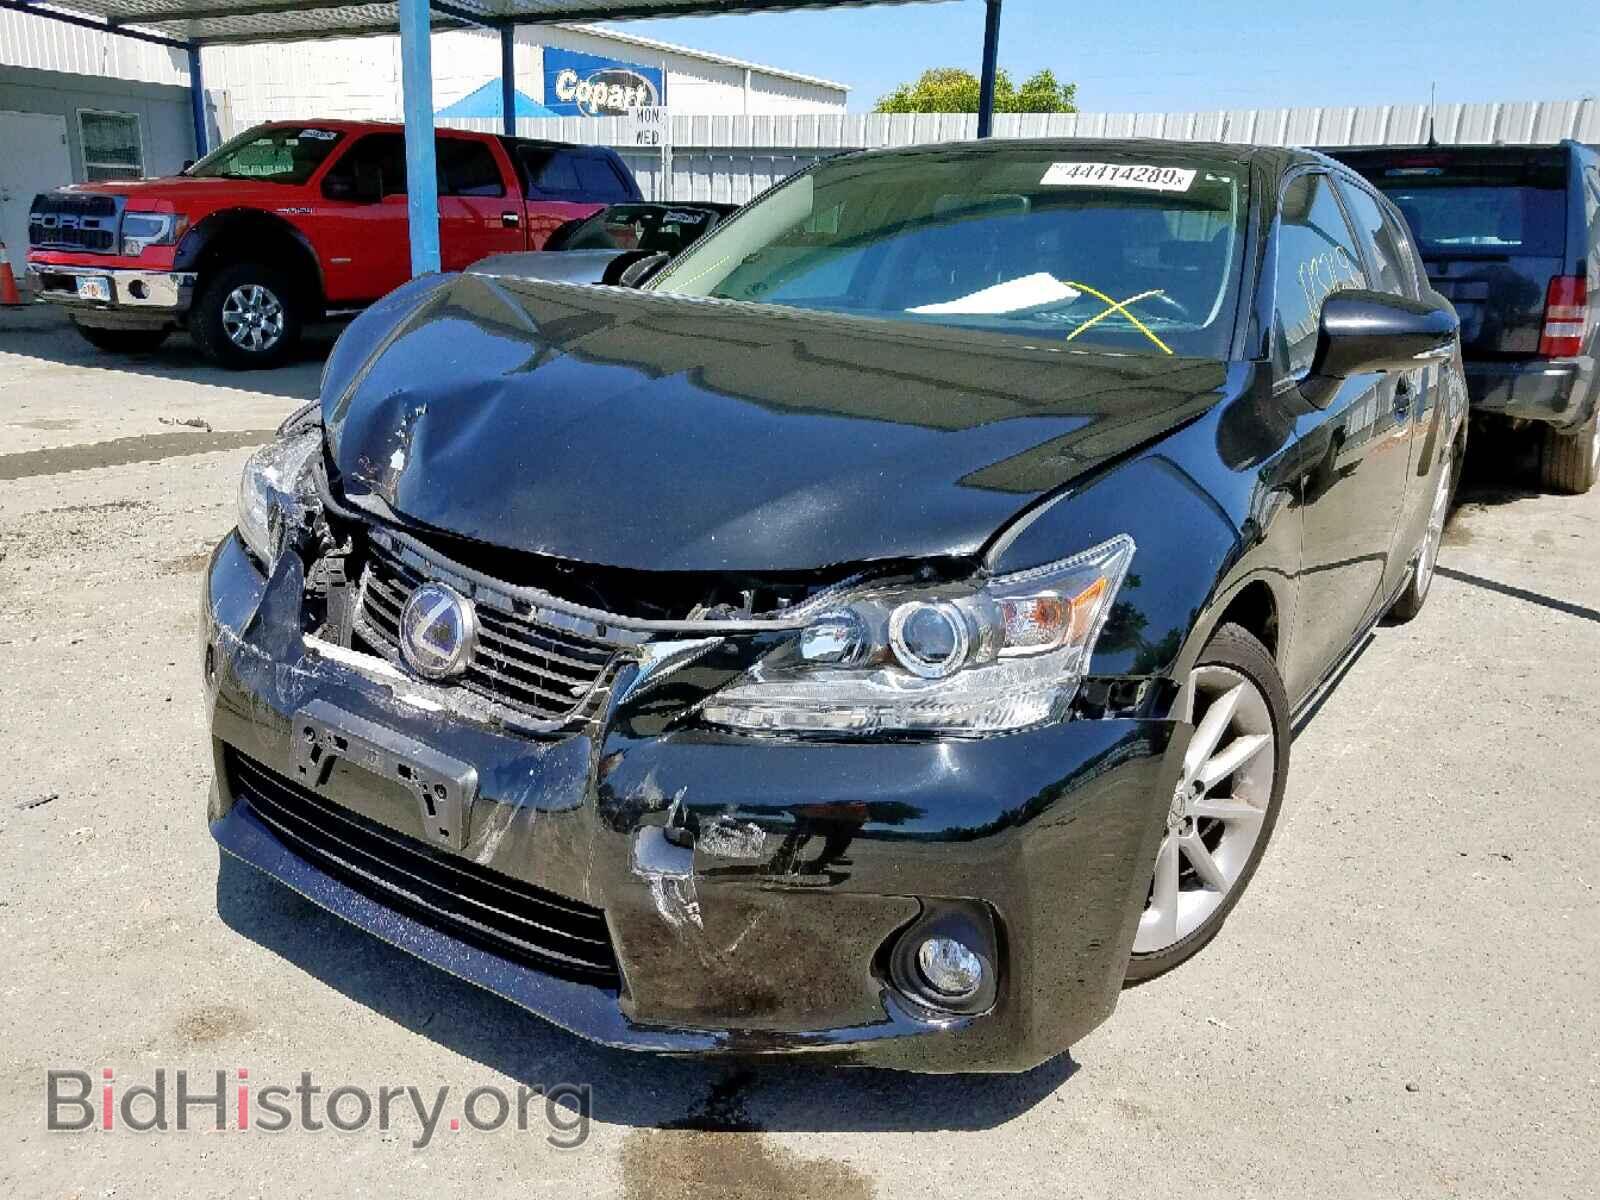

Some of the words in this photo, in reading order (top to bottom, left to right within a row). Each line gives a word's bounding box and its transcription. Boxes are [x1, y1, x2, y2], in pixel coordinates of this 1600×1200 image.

[556, 69, 647, 113] Copart
[636, 108, 660, 123] MON
[636, 130, 660, 145] WED
